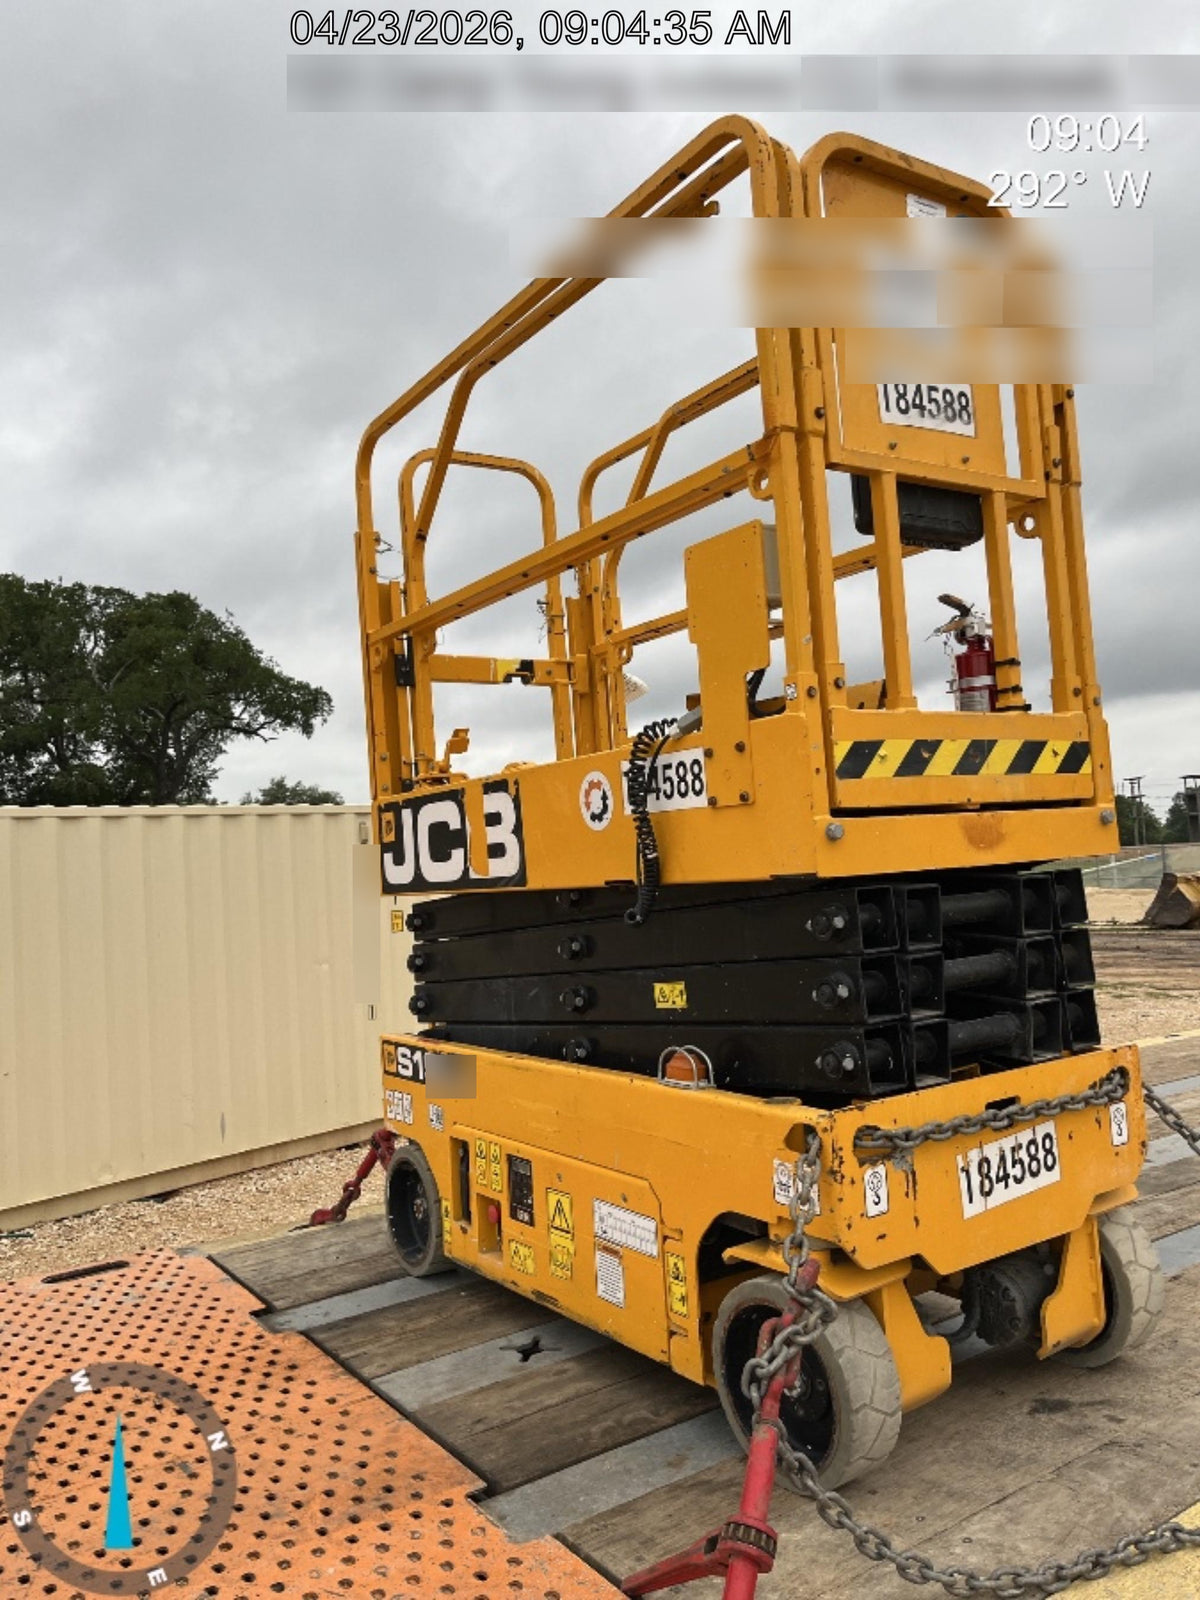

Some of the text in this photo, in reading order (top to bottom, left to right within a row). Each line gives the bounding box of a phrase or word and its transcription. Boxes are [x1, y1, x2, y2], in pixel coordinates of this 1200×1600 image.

[883, 384, 971, 425] 184588
[624, 759, 704, 800] 4588
[384, 791, 520, 884] JCB
[960, 1132, 1056, 1204] 184588
